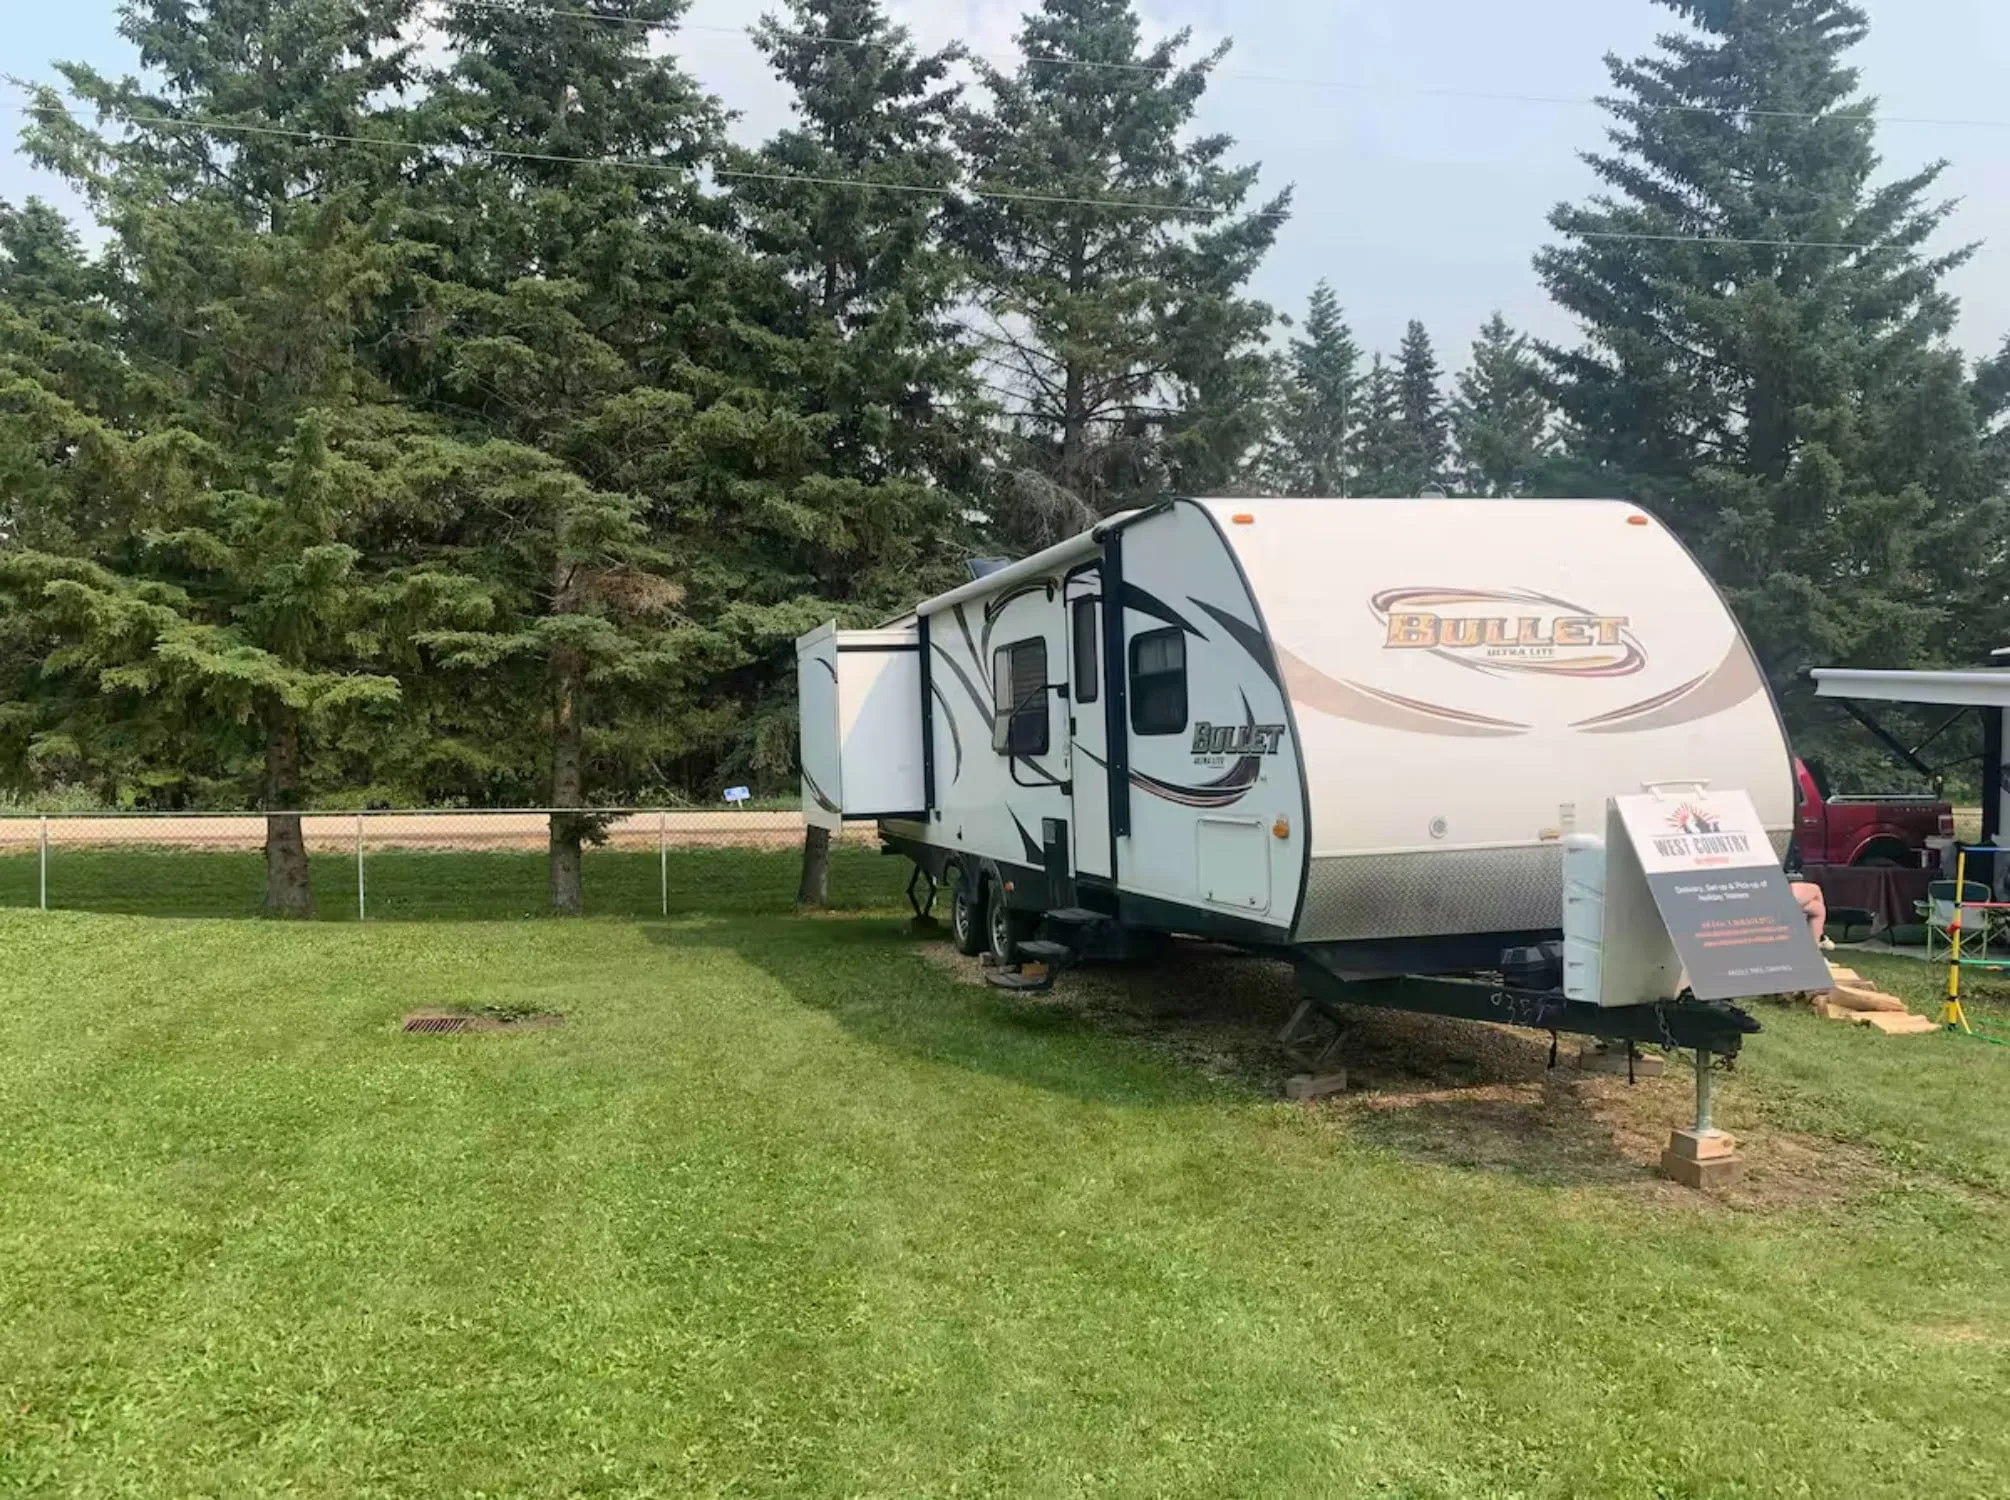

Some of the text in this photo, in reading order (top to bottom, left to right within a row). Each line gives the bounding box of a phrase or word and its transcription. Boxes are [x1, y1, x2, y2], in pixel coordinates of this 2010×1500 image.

[1382, 612, 1629, 649] BULLET
[1487, 648, 1555, 657] ULTRA LITE
[1190, 721, 1286, 755] BULLET
[1652, 835, 1750, 857] WEST COUNTRY
